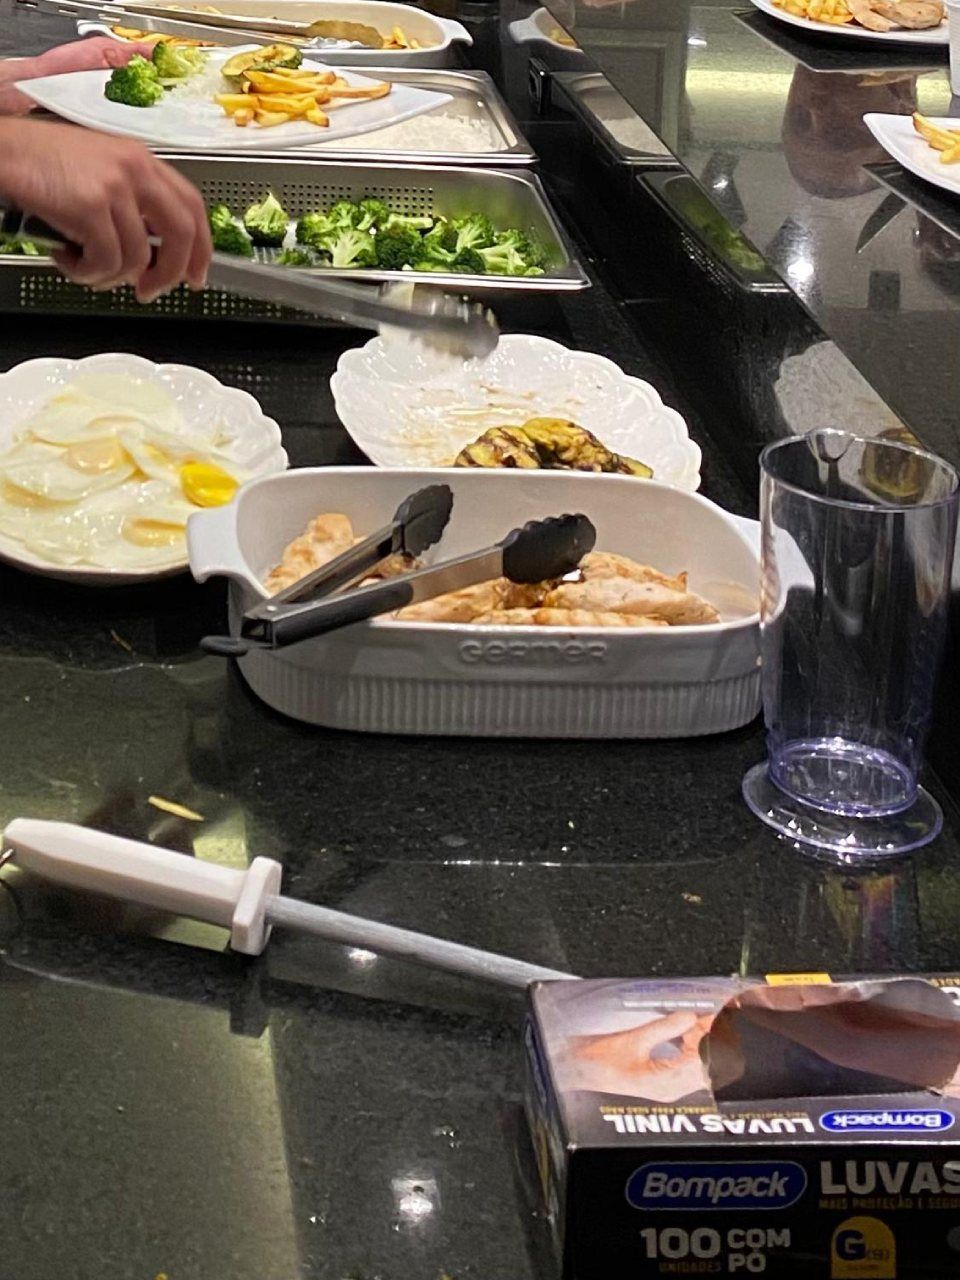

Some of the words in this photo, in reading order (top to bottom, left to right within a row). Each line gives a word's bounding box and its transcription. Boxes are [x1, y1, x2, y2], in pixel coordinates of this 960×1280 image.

[604, 1114, 698, 1134] VINIL
[701, 1113, 815, 1135] LUVAS
[833, 1113, 941, 1129] Bompack
[642, 1170, 790, 1204] Bompack
[640, 1227, 721, 1260] 100
[726, 1227, 791, 1249] COM
[836, 1230, 867, 1261] G
